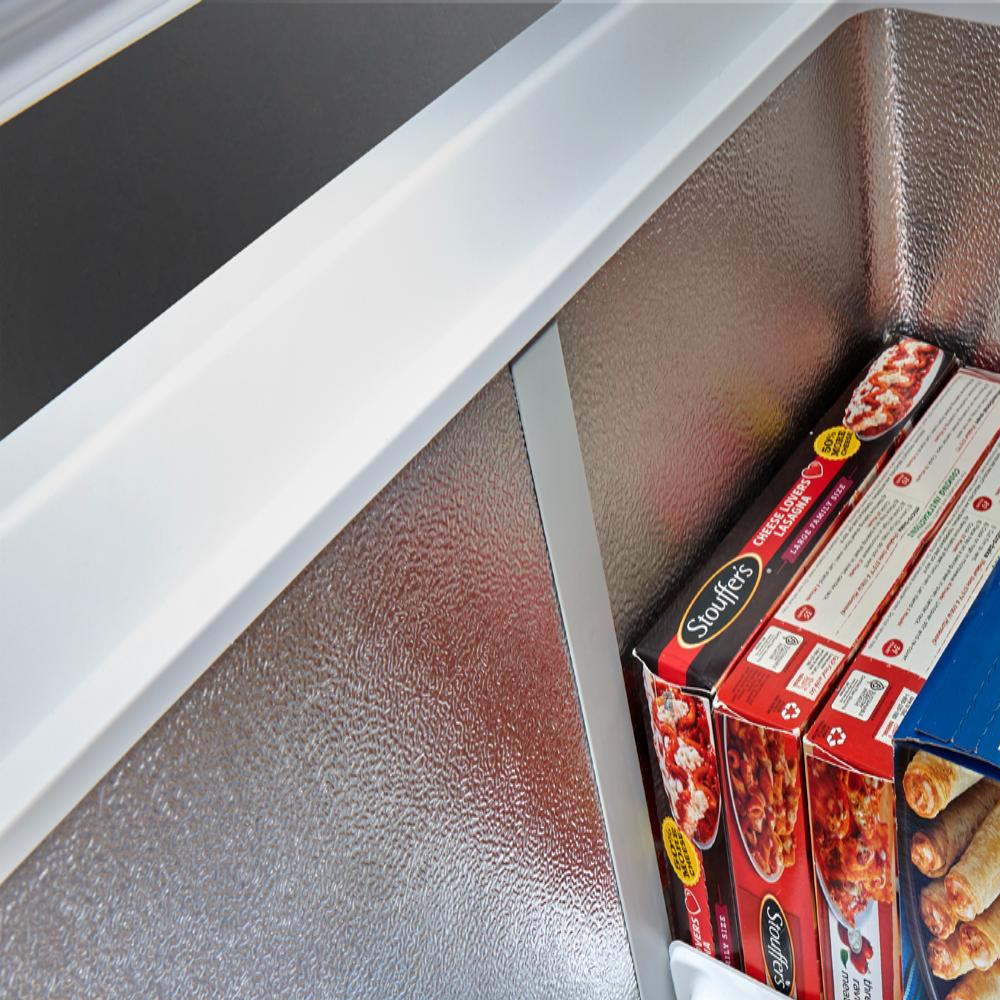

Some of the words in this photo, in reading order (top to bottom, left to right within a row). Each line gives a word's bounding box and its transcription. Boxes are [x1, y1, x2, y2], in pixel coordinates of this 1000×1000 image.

[753, 511, 783, 547] CHEESE
[779, 478, 811, 513] LOVERS
[773, 495, 812, 538] LASAGNA
[788, 528, 813, 555] LARGE
[808, 500, 834, 529] FAMILY
[829, 482, 847, 501] SIZE
[686, 563, 754, 639] Stouffer's
[673, 826, 690, 877] MORE
[681, 830, 696, 877] CHEESE
[766, 905, 792, 989] Stouffer's
